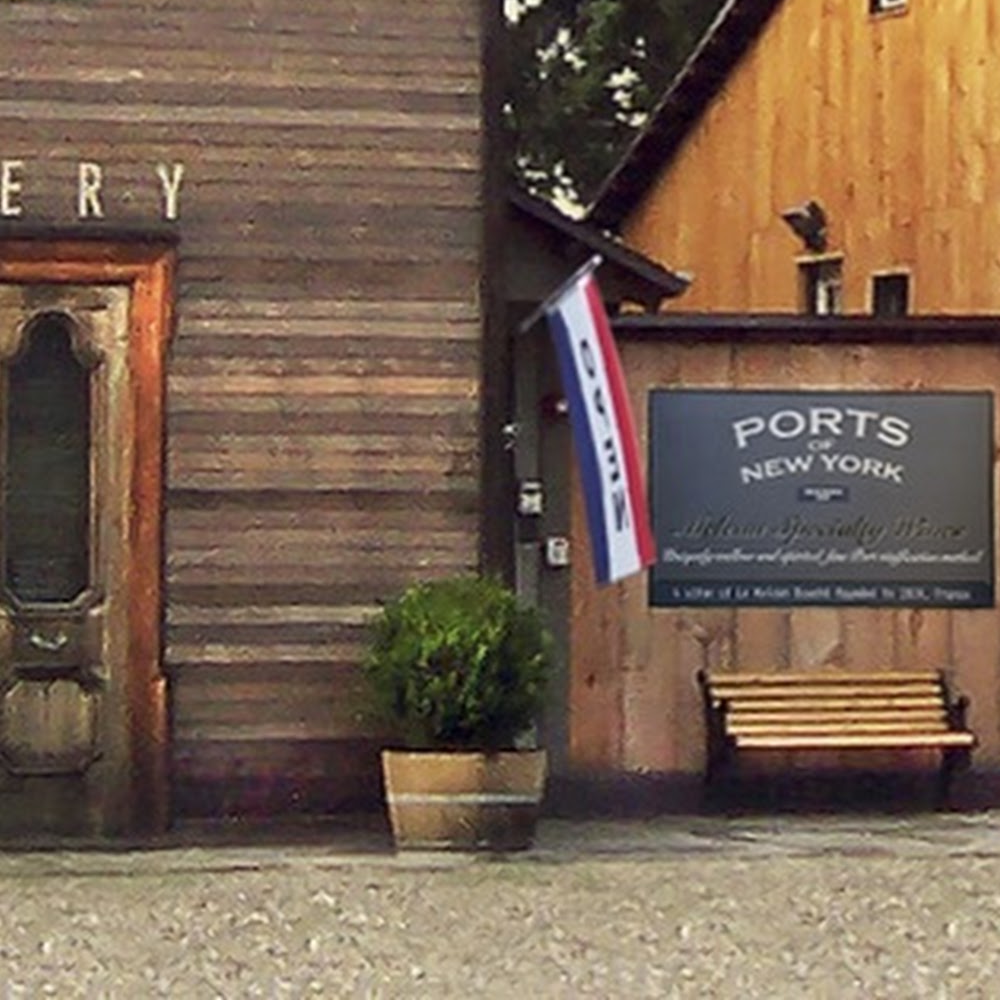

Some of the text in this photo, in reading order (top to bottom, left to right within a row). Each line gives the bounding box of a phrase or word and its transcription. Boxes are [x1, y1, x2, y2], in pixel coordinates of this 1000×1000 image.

[1, 160, 184, 219] ERY
[732, 407, 912, 449] PORTS
[807, 438, 835, 452] OF
[740, 454, 904, 485] NEW YORK
